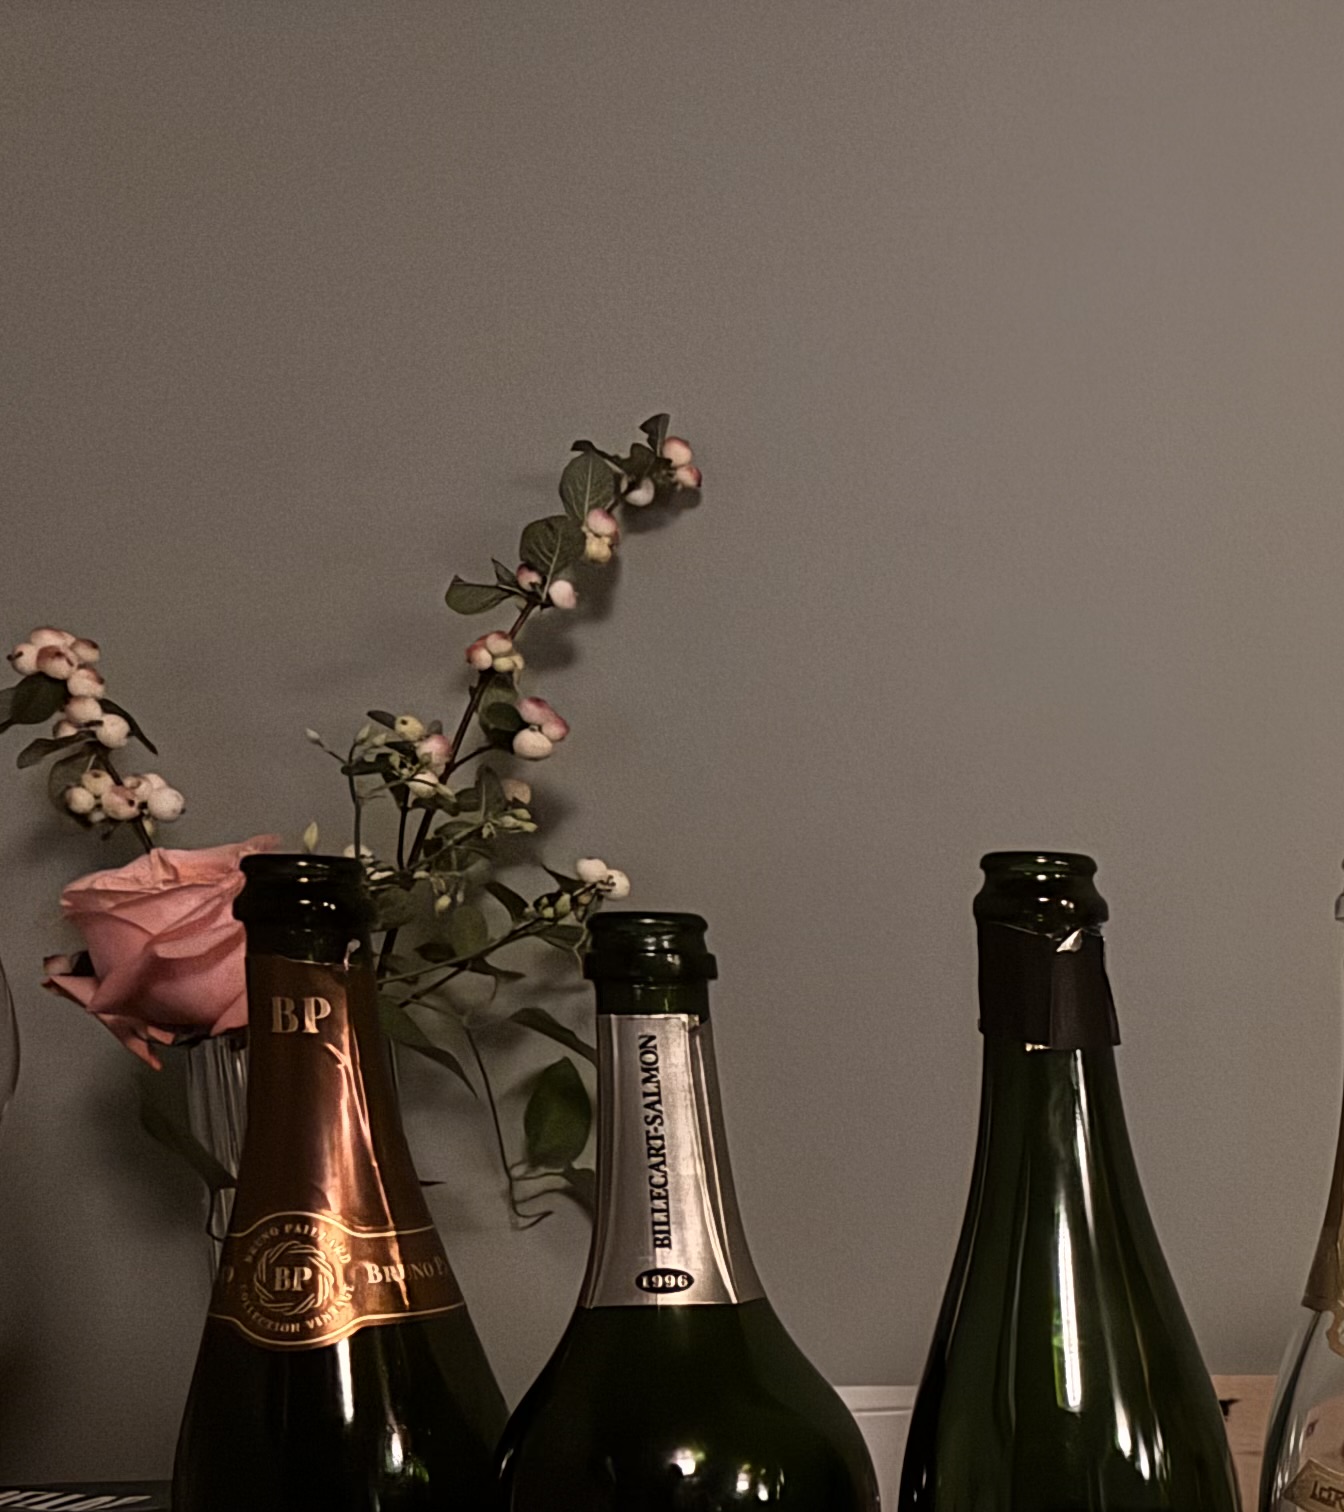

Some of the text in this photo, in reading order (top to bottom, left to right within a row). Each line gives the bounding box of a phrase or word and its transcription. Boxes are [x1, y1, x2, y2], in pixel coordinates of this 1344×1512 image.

[271, 996, 331, 1034] BP
[638, 1034, 672, 1250] BILLECART-SALMON
[273, 1266, 313, 1291] BP
[363, 1261, 434, 1285] BRUNO
[641, 1272, 689, 1289] 1996
